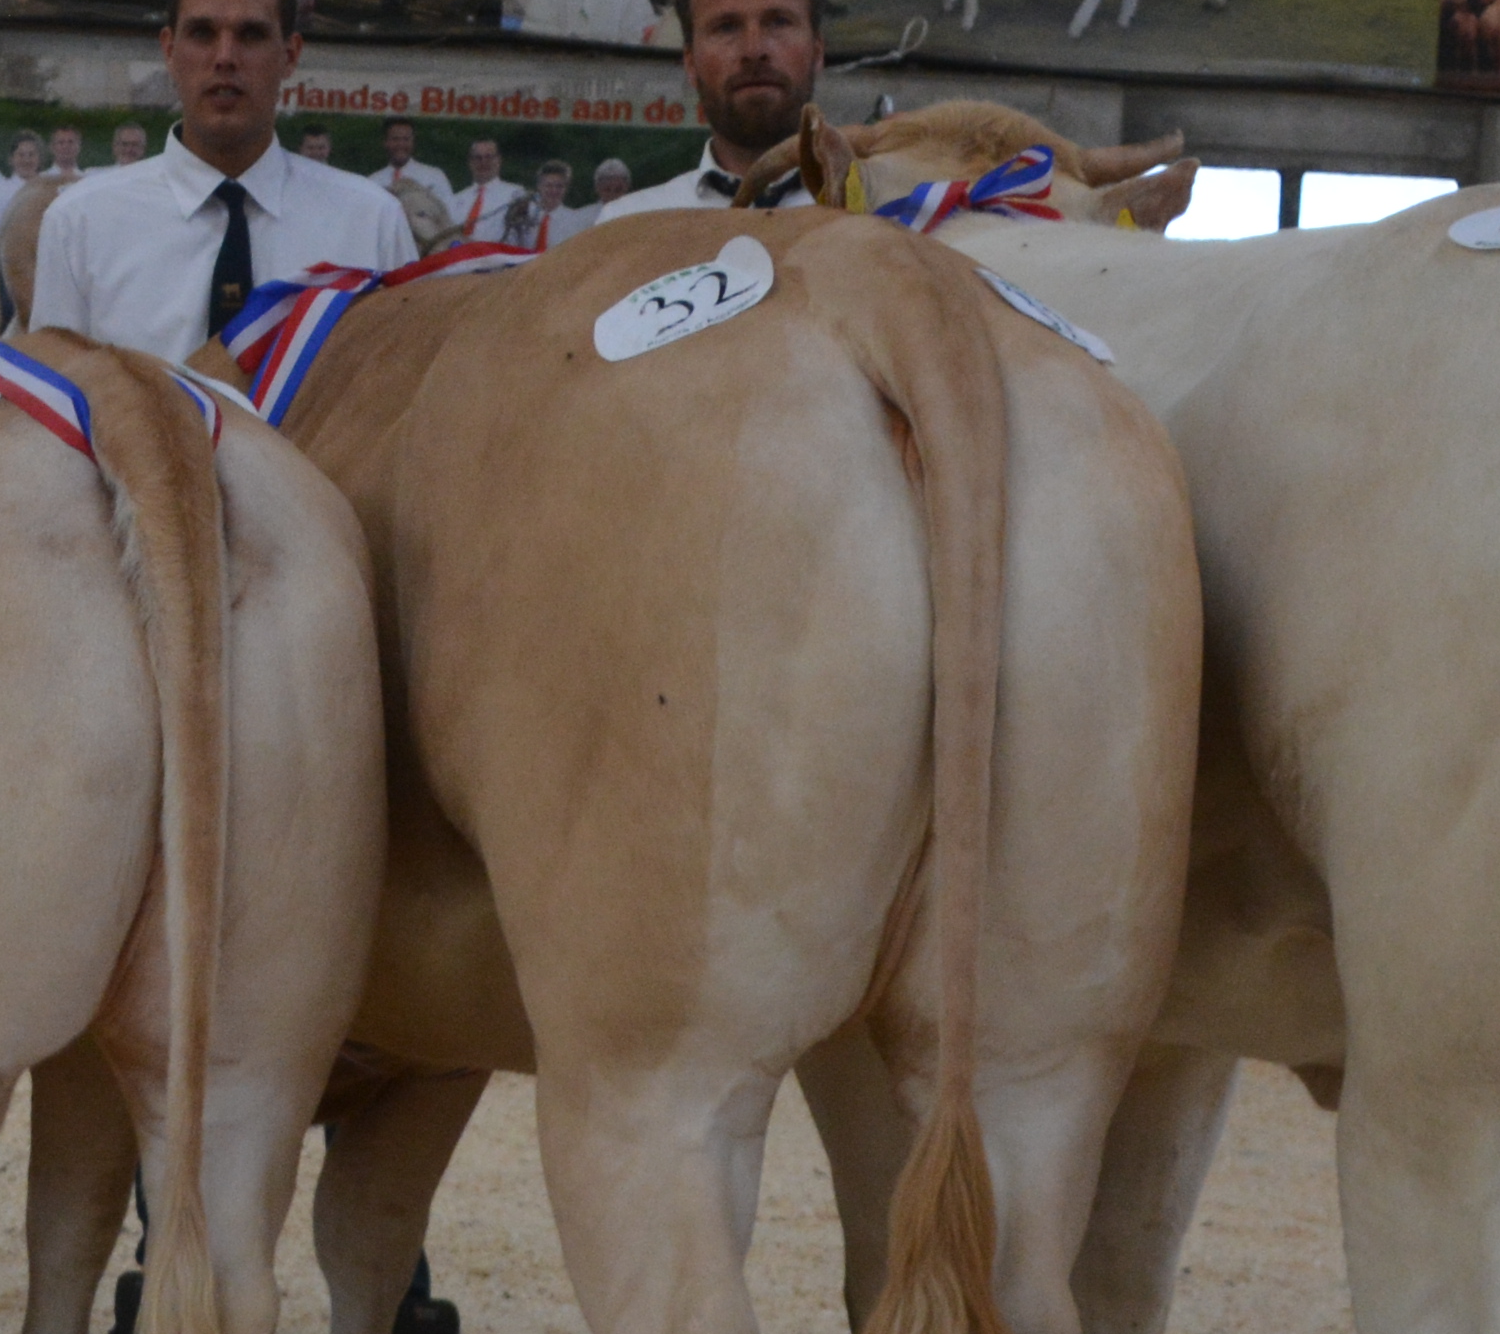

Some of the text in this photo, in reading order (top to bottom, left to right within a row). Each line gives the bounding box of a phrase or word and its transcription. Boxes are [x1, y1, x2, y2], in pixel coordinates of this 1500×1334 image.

[282, 81, 409, 113] rlandse
[421, 86, 561, 120] Blondes
[572, 98, 633, 122] aan
[644, 95, 686, 125] de
[639, 270, 760, 337] 32
